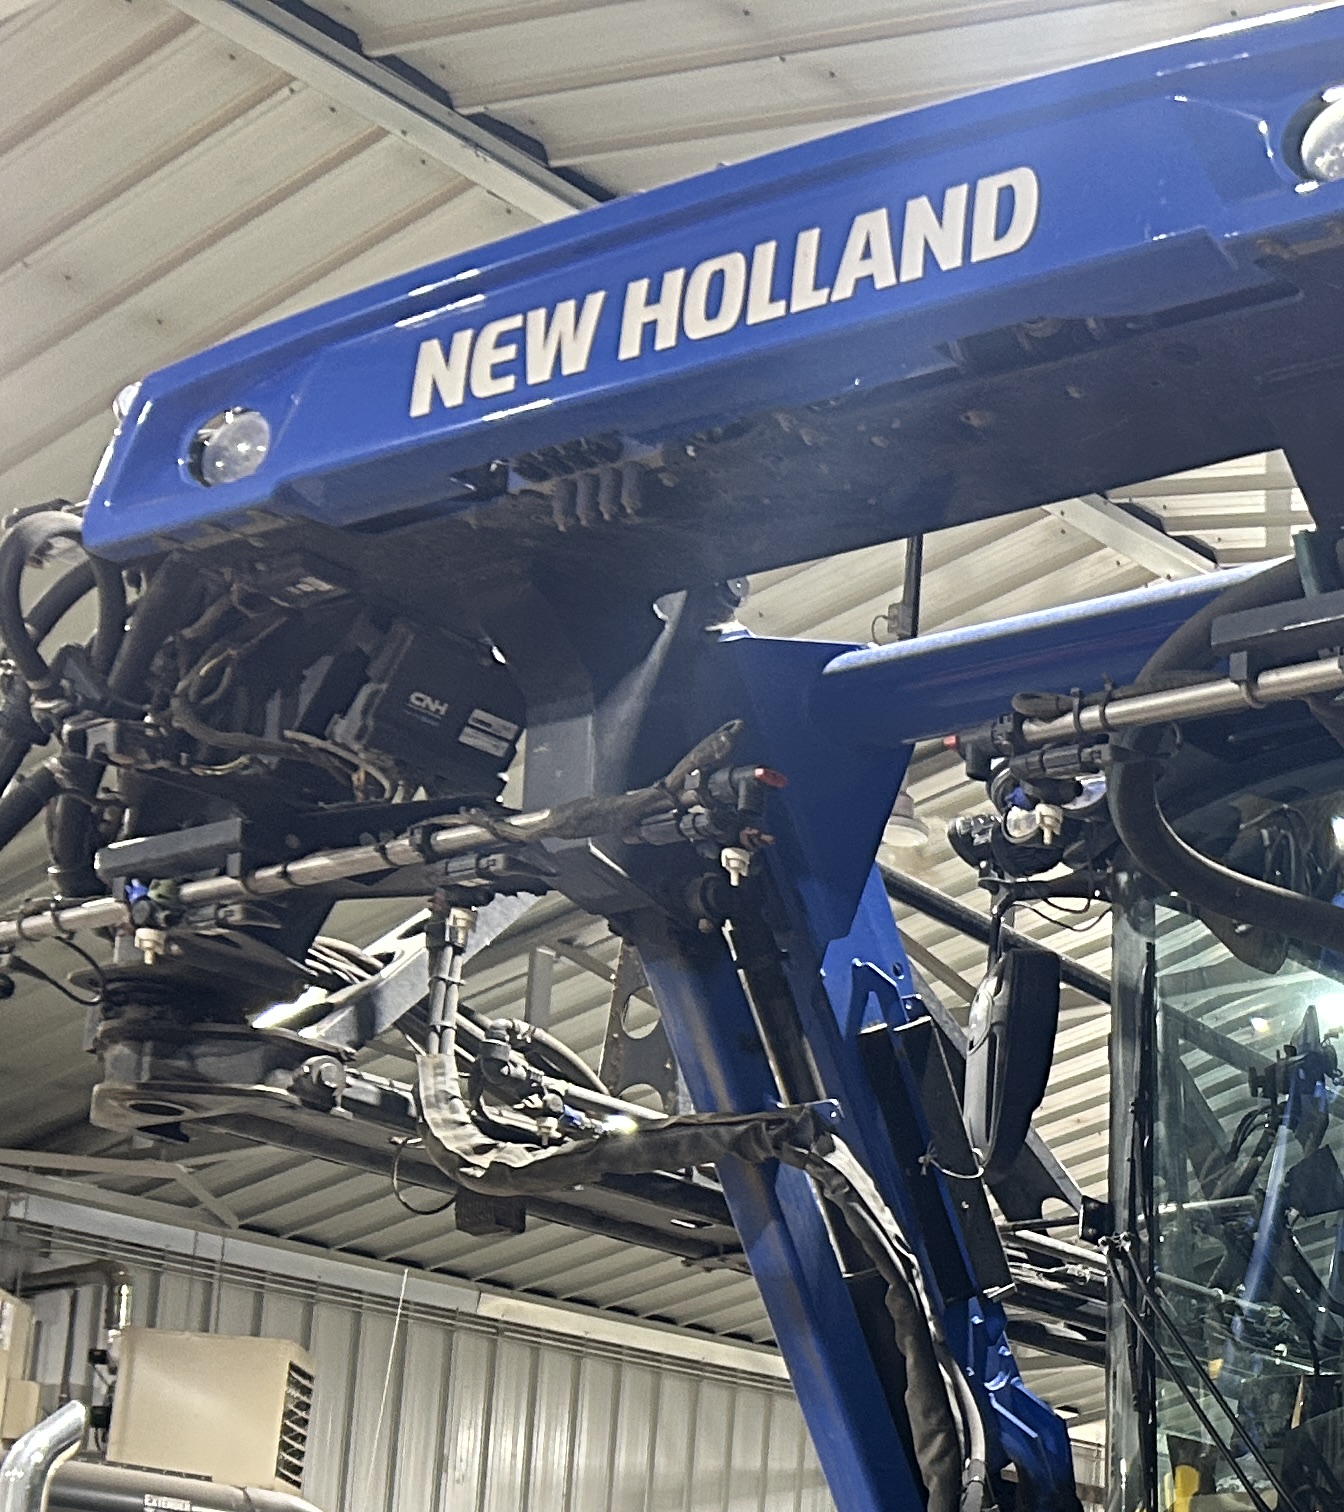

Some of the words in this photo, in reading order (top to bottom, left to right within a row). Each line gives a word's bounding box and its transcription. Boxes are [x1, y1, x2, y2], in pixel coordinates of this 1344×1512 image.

[409, 289, 607, 419] NEW
[617, 166, 1040, 361] HOLLAND
[409, 691, 449, 716] CNH
